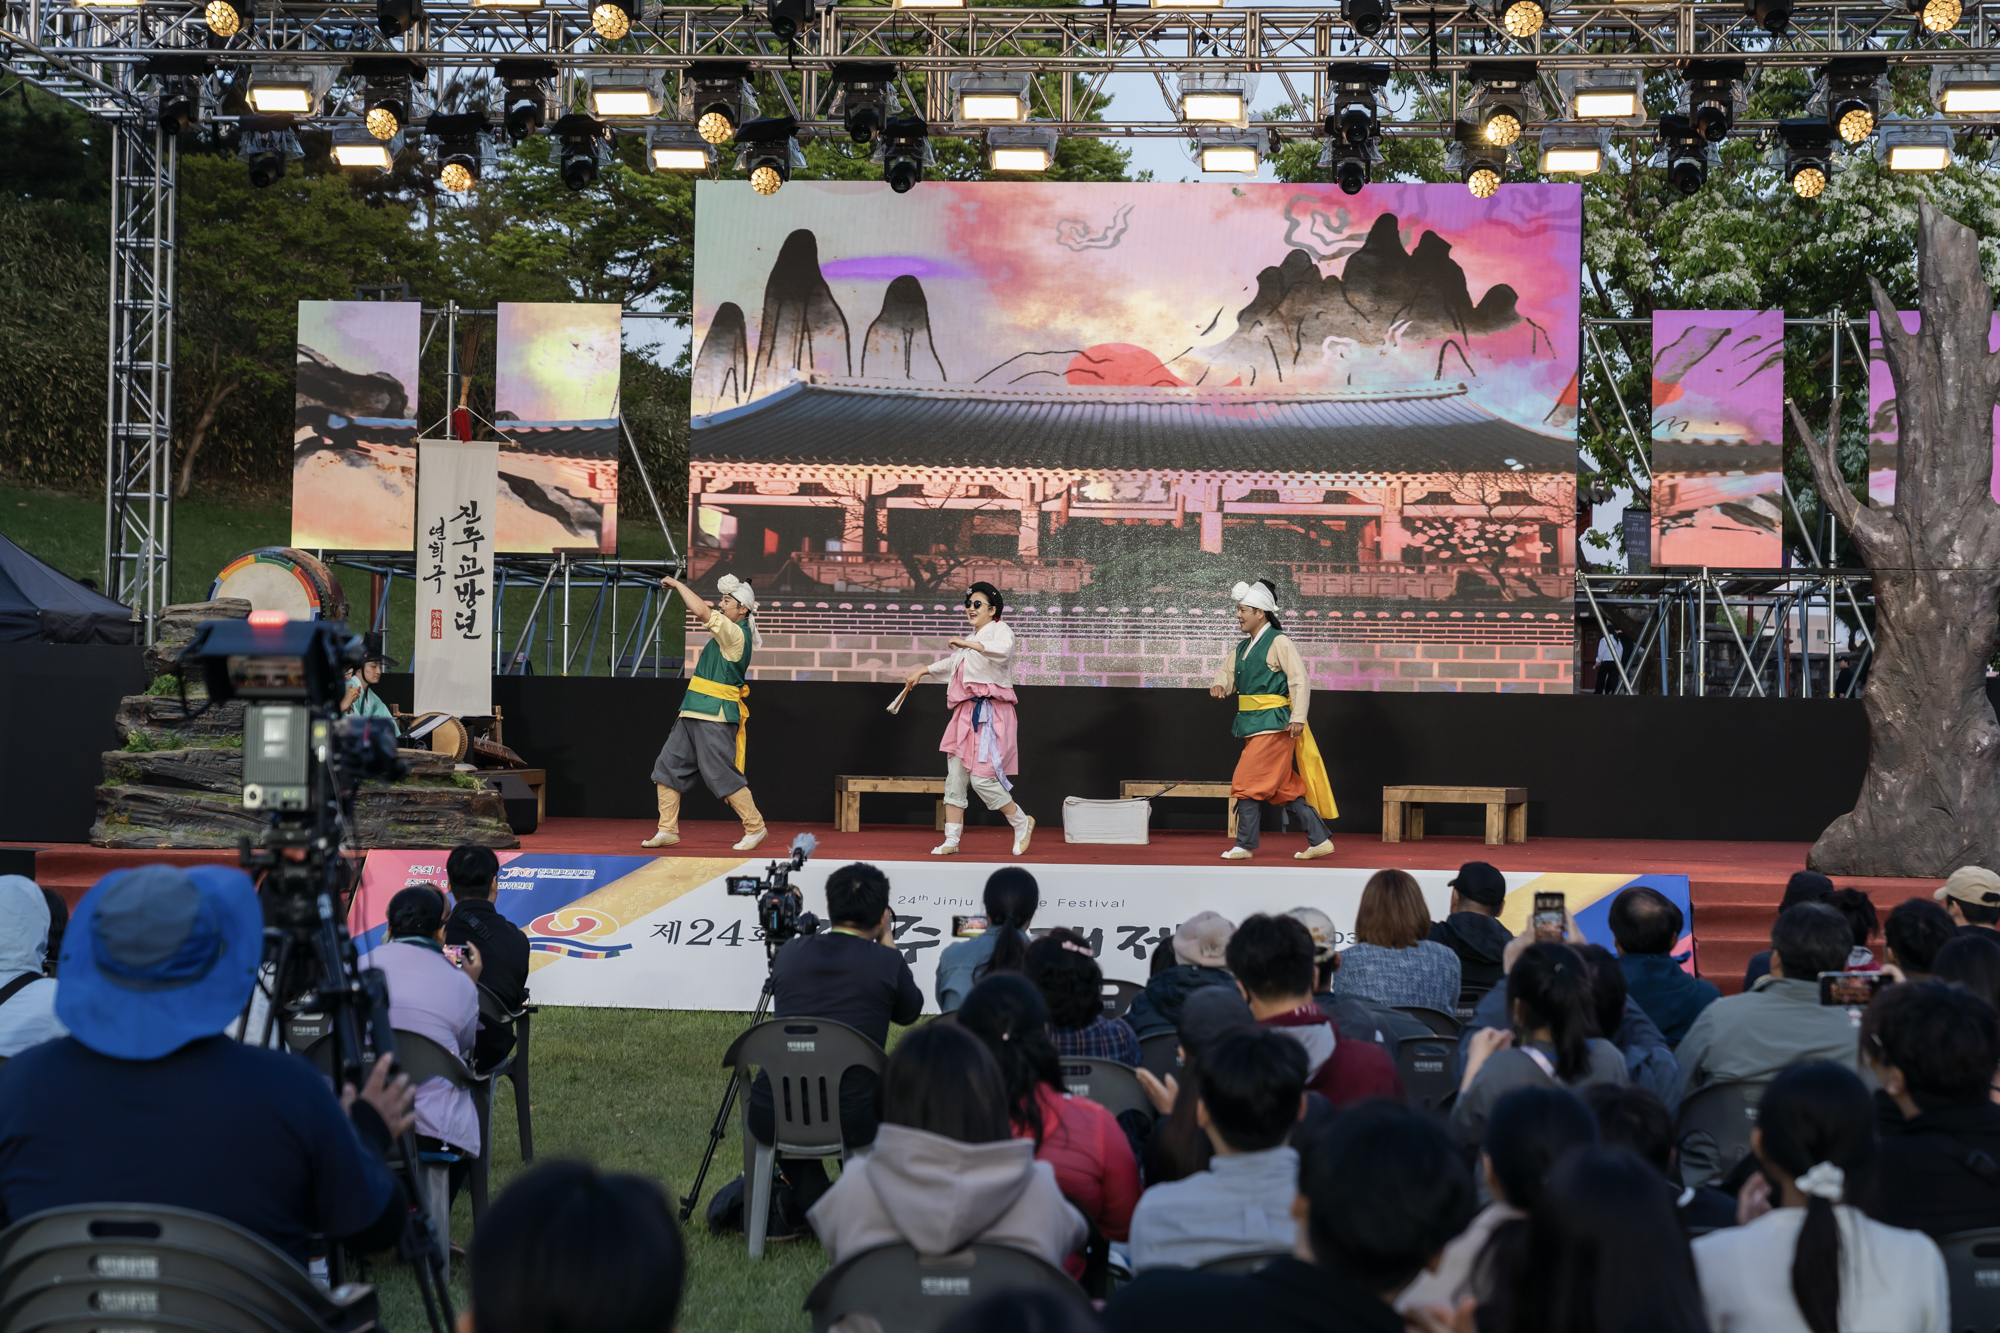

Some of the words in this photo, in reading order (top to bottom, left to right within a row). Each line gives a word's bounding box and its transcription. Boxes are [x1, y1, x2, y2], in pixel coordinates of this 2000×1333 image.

[423, 517, 446, 594] 연희극
[449, 500, 485, 640] 진주교방뎐
[408, 865, 434, 875] 주최
[897, 895, 928, 905] 24th
[933, 896, 974, 907] Jinju
[1057, 898, 1126, 908] Festival
